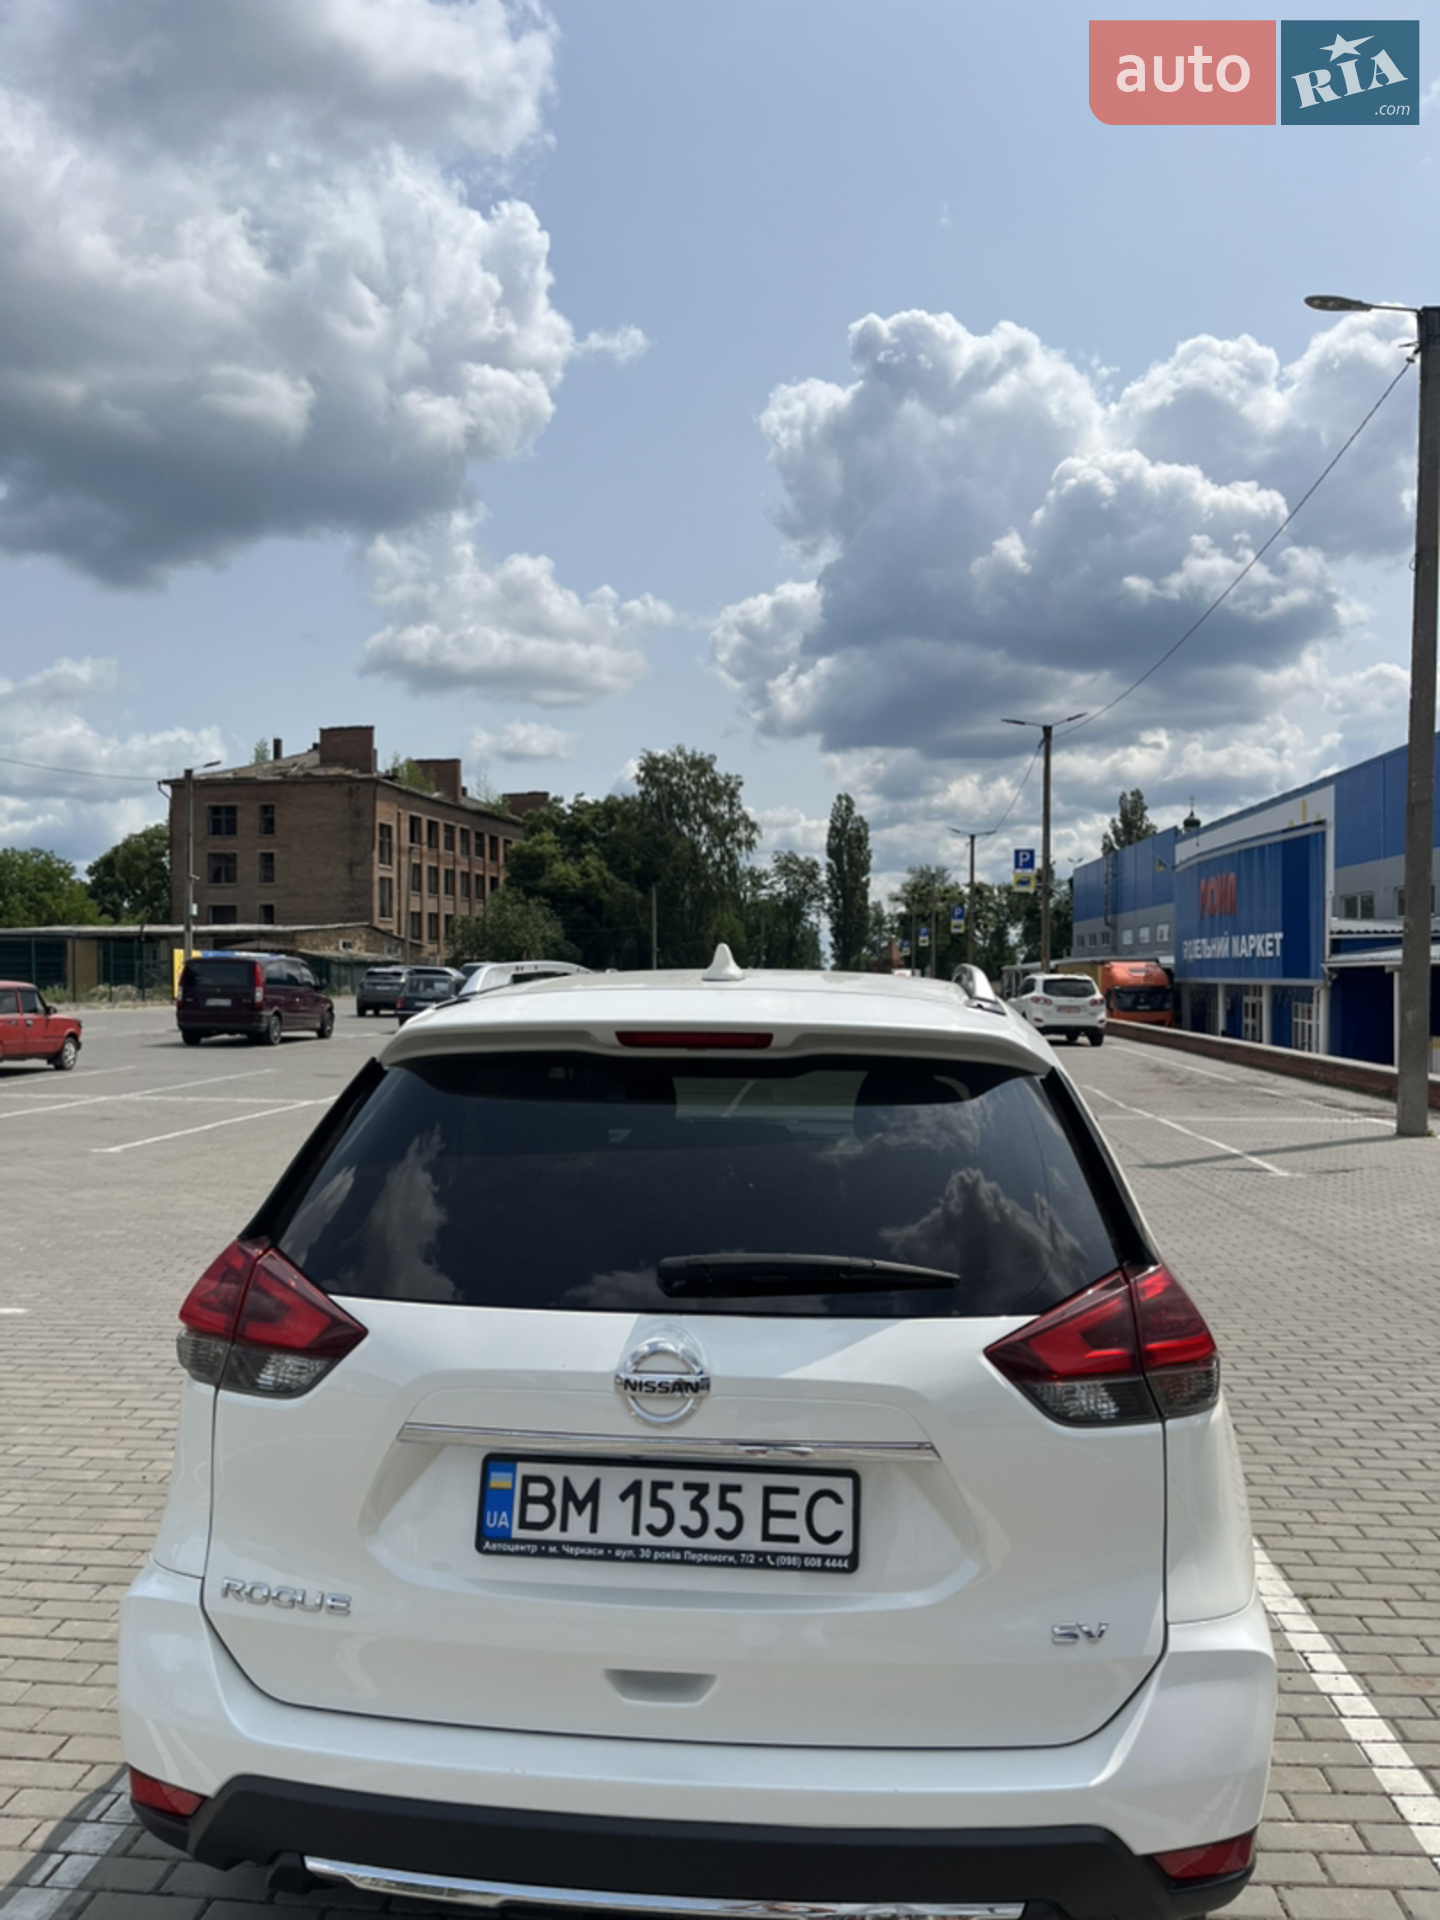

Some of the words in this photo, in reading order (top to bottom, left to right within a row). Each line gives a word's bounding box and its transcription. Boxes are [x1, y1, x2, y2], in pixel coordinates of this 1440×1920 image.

[1018, 851, 1031, 867] P
[1231, 931, 1284, 959] МАРКЕТ
[623, 1378, 700, 1395] NISSAN
[486, 1511, 510, 1529] UA
[518, 1474, 602, 1534] BM
[618, 1479, 744, 1541] 1535
[761, 1485, 845, 1545] EC
[483, 1541, 538, 1554] Автоцентр
[561, 1544, 604, 1557] Черкаси
[614, 1548, 636, 1560] вул.
[639, 1548, 651, 1559] 30
[653, 1550, 681, 1561] років
[740, 1553, 756, 1564] 7/2
[221, 1576, 352, 1616] ROGUE
[1052, 1621, 1109, 1645] SV
